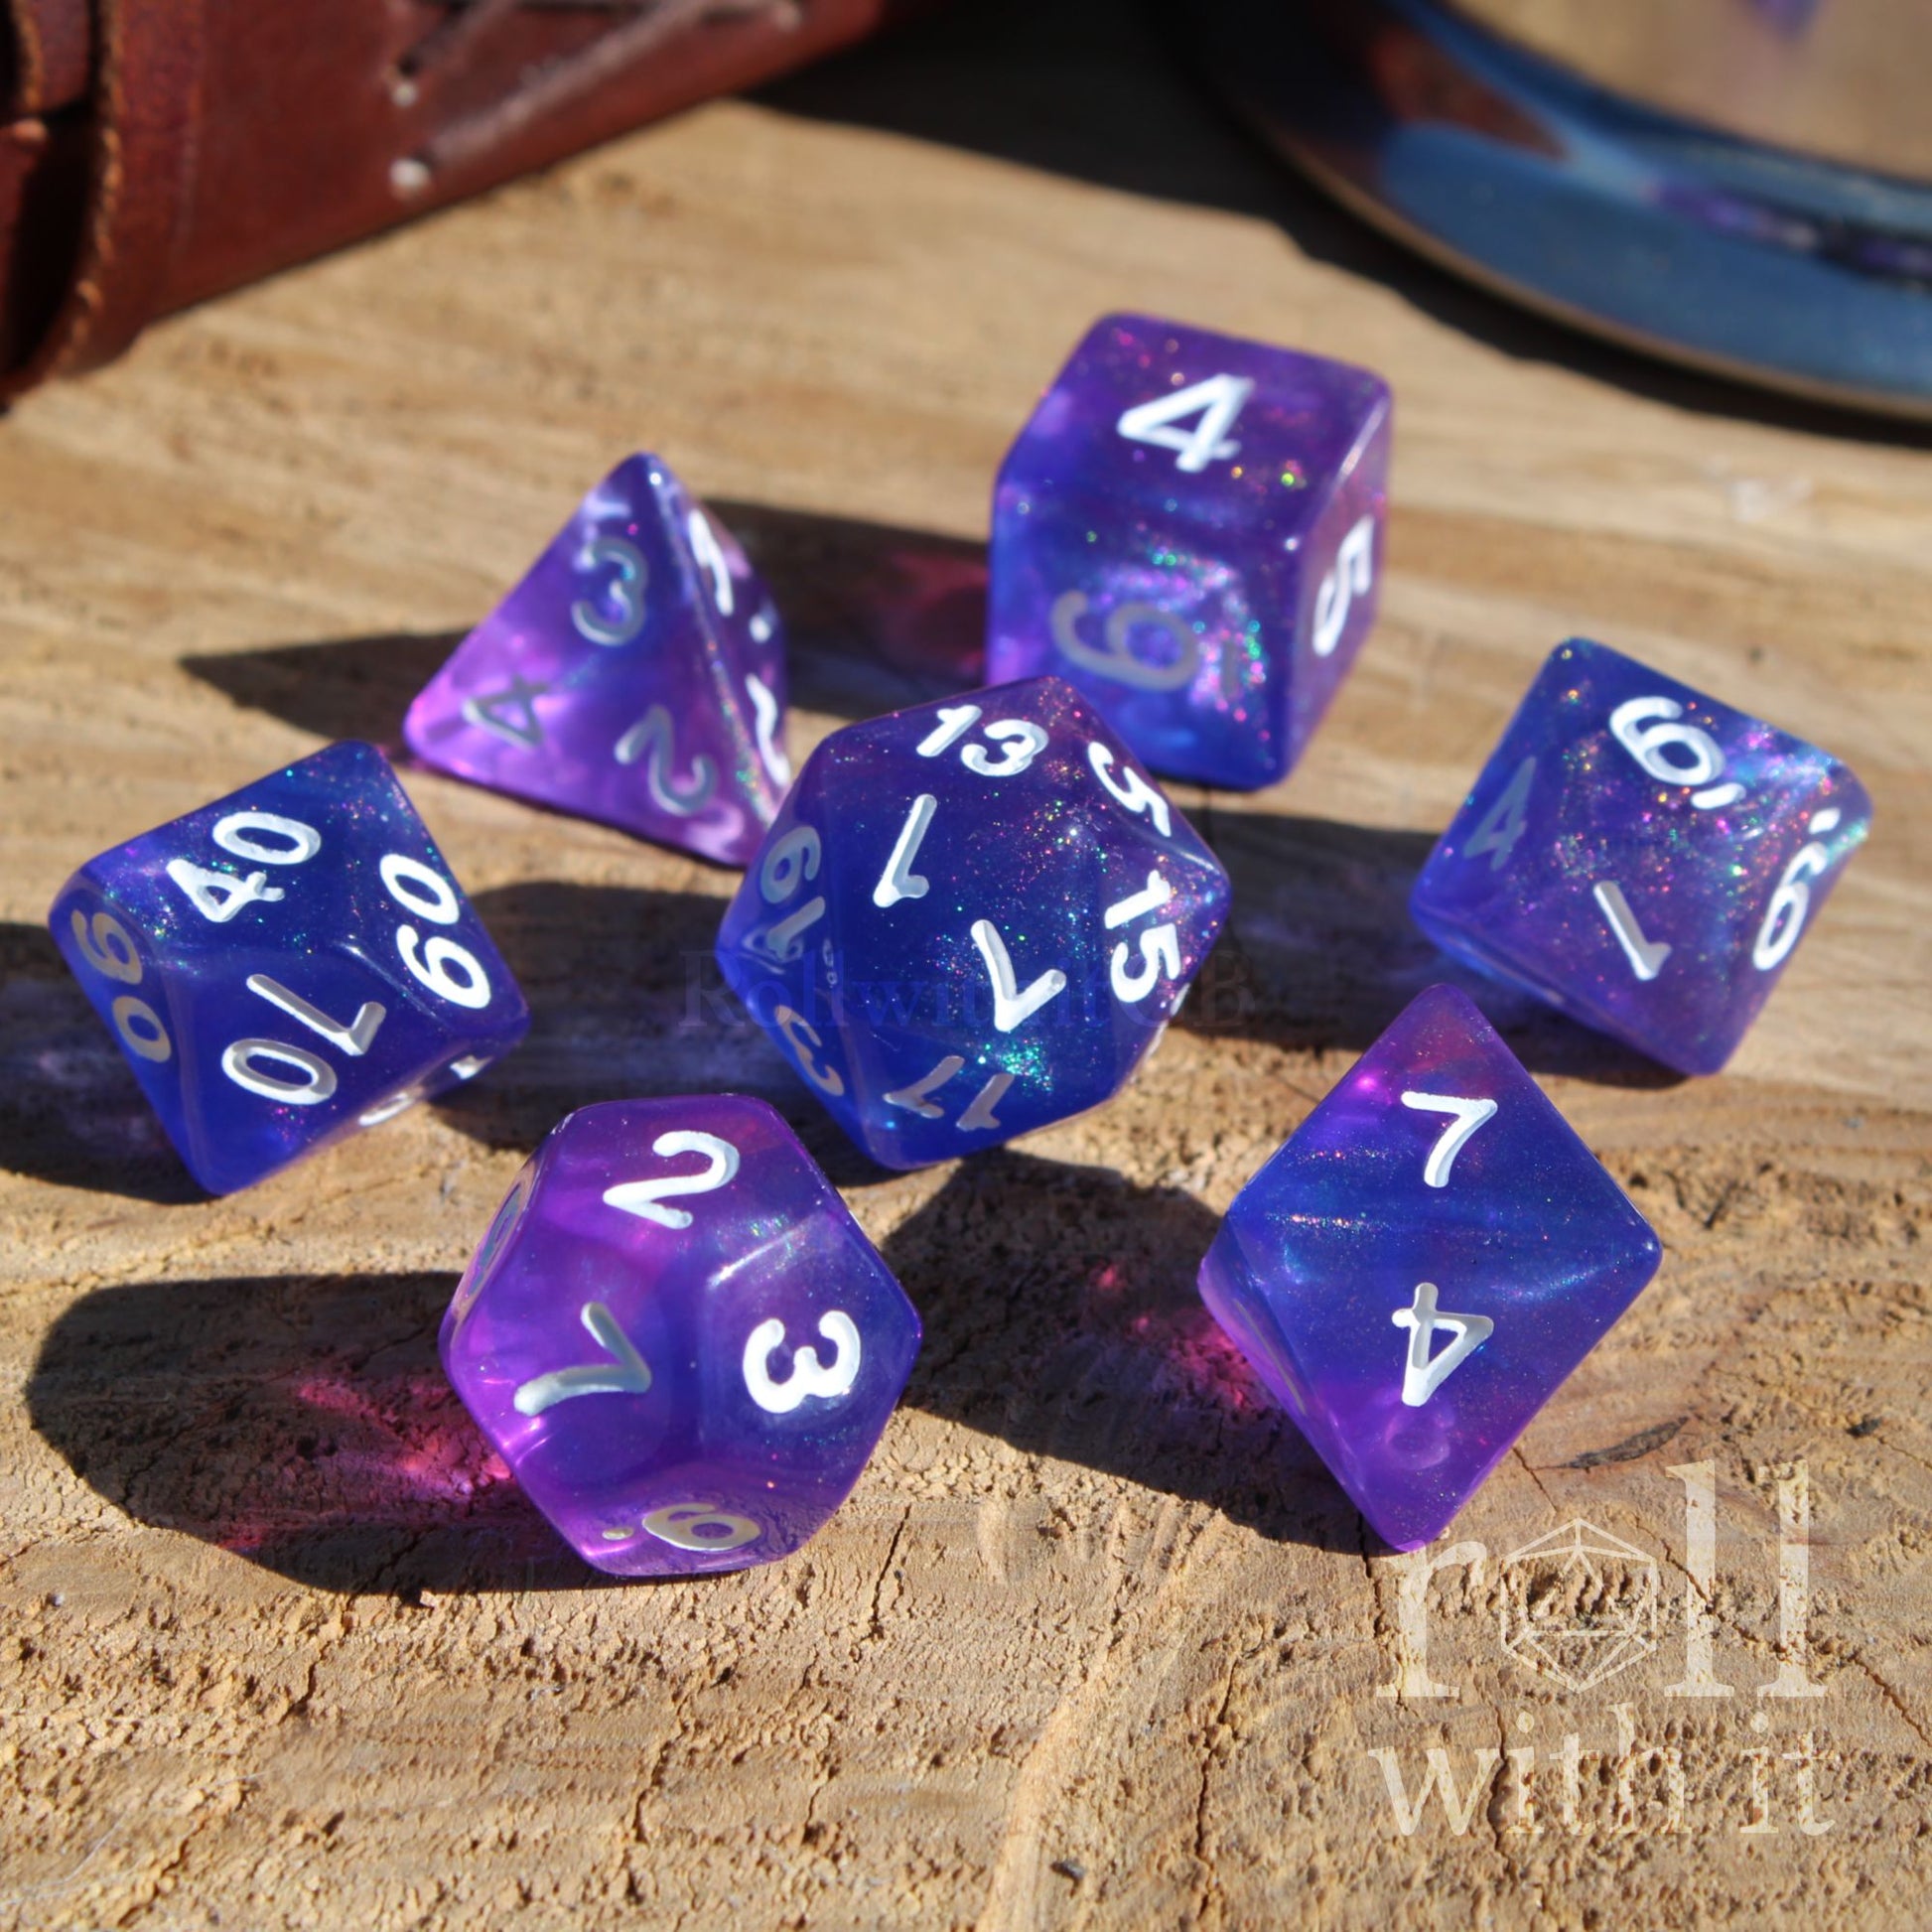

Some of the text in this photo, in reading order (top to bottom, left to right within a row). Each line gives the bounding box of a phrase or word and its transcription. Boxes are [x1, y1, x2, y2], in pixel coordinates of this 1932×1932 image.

[1117, 373, 1254, 472] 4
[570, 536, 648, 645] 3
[615, 705, 718, 816] 2
[916, 704, 1048, 776] 13
[167, 811, 323, 923] 40
[873, 793, 937, 908] 1
[1463, 757, 1538, 871] 4
[971, 919, 1067, 1033] 7
[1104, 870, 1181, 1003] 15
[603, 1130, 740, 1229] 2
[1401, 1091, 1497, 1187] 7
[513, 1302, 651, 1417] 7
[743, 1311, 862, 1414] 3
[1392, 1282, 1494, 1407] 4
